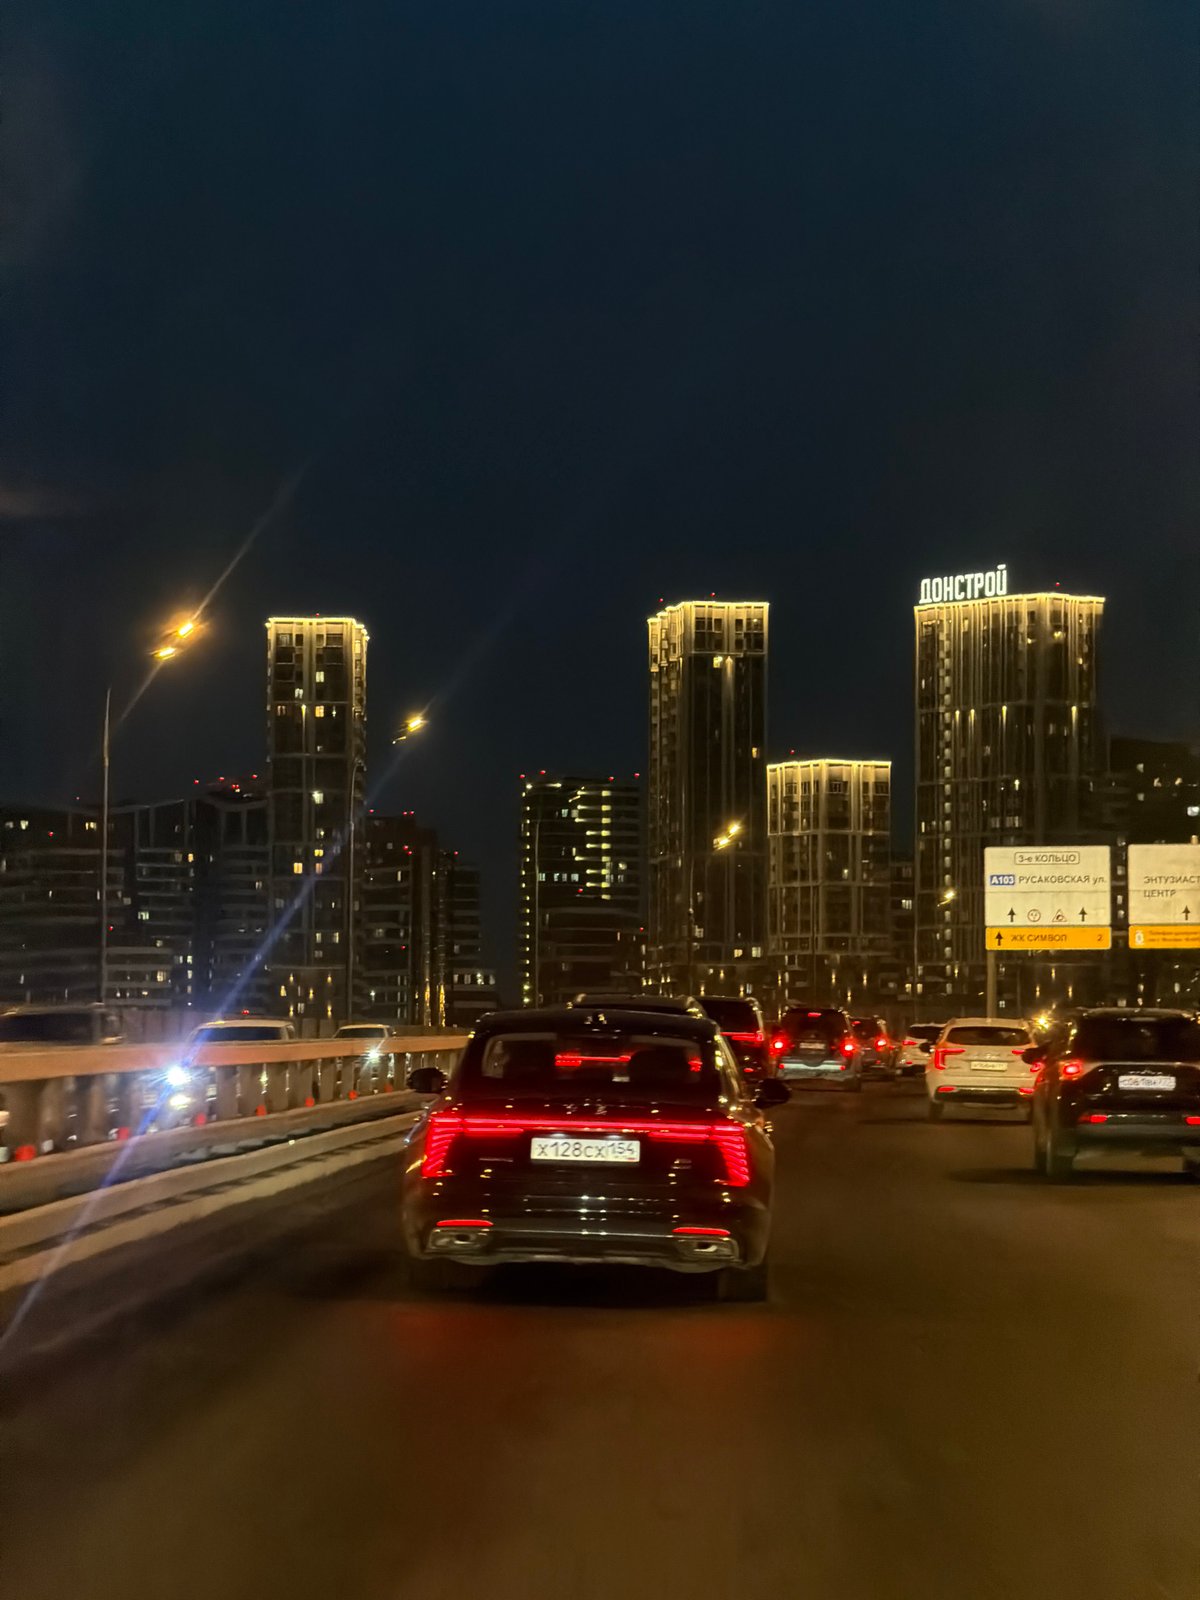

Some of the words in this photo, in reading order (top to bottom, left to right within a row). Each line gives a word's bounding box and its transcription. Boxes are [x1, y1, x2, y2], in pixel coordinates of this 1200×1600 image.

[919, 563, 1007, 604] ДОНСТРОЙ
[1018, 855, 1032, 863] 3-е
[1035, 854, 1077, 864] КОЛЬЦО
[1018, 875, 1090, 884] РУСАКОВСКАЯ
[1093, 876, 1107, 885] ул.
[1143, 889, 1176, 899] ЦЕНТР
[1011, 934, 1025, 942] ЖК
[1027, 934, 1067, 942] СИМВОЛ
[1097, 934, 1102, 942] 2
